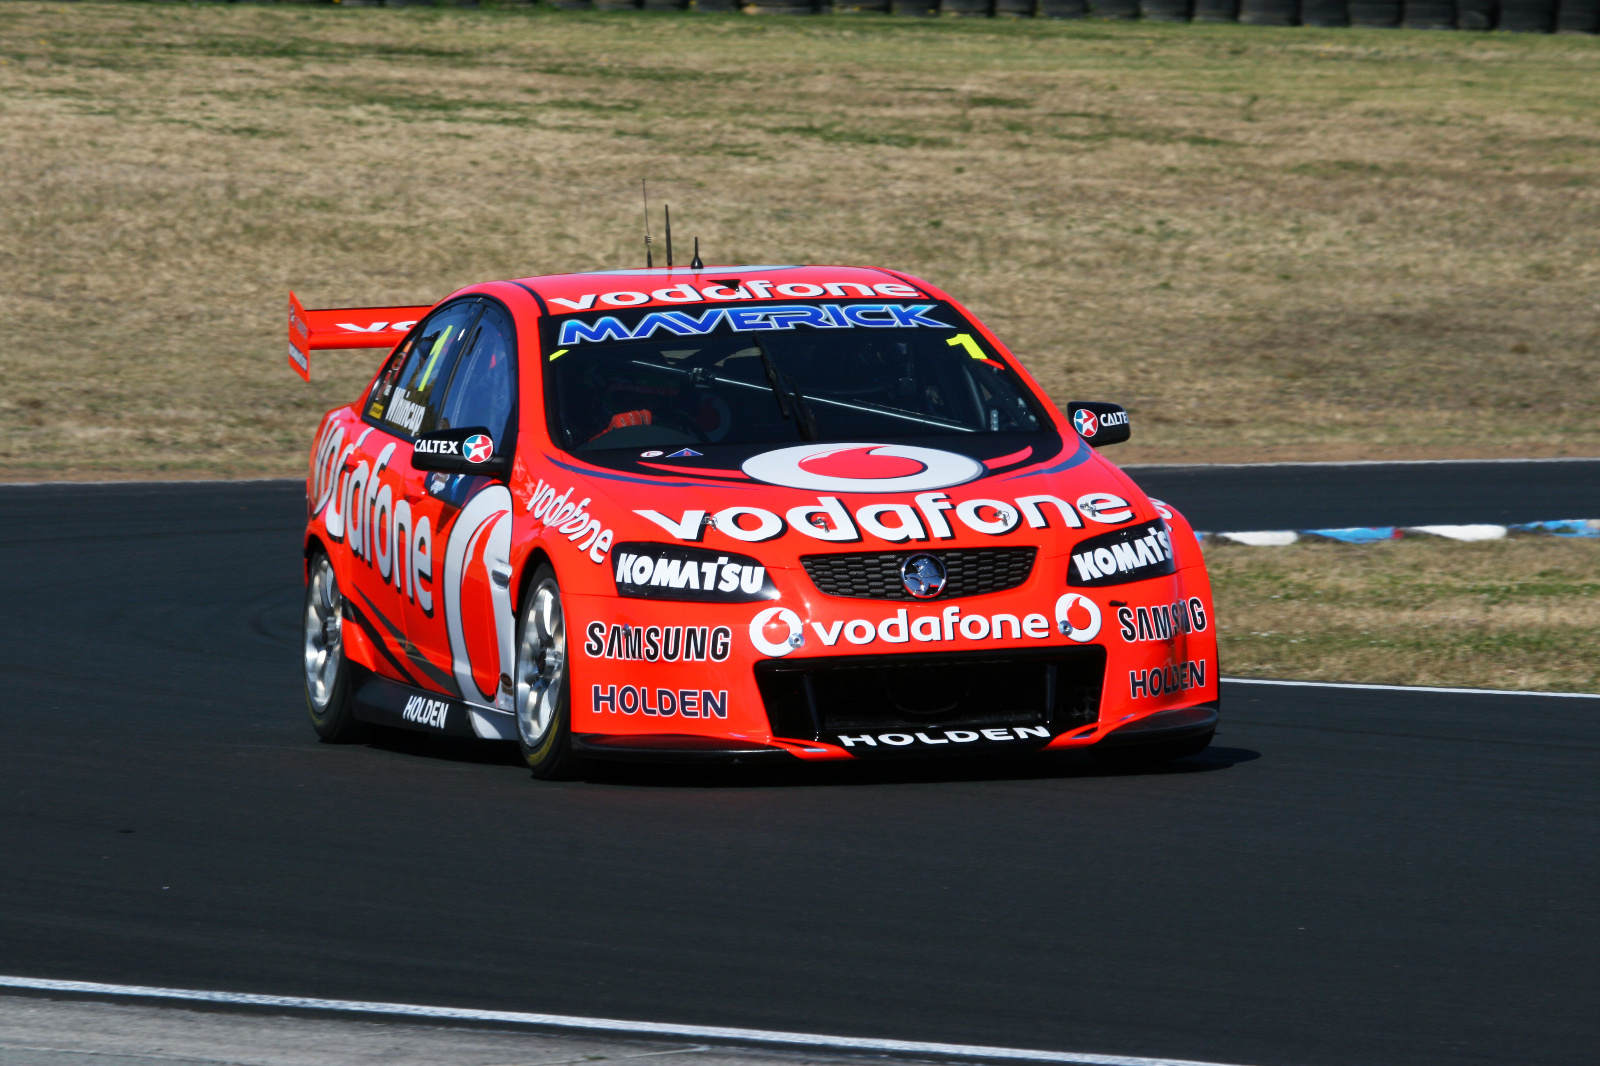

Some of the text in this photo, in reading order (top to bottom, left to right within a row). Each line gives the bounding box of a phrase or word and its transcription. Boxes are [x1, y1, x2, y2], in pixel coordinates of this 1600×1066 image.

[548, 280, 919, 311] vodafone
[557, 304, 956, 347] MAVERICK
[946, 334, 988, 359] 1
[418, 325, 453, 391] 1
[414, 439, 458, 454] CALTEX
[309, 412, 434, 620] vodafone
[526, 479, 614, 565] vodafone
[632, 491, 1136, 545] vodafone
[614, 554, 765, 596] KOMATSU
[585, 621, 732, 663] SAMSUNG
[811, 605, 1050, 647] vodafone
[1129, 659, 1206, 699] HOLDEN
[402, 694, 449, 730] HOLDEN
[591, 684, 729, 720] HOLDEN
[837, 725, 1052, 748] HOLDEN
